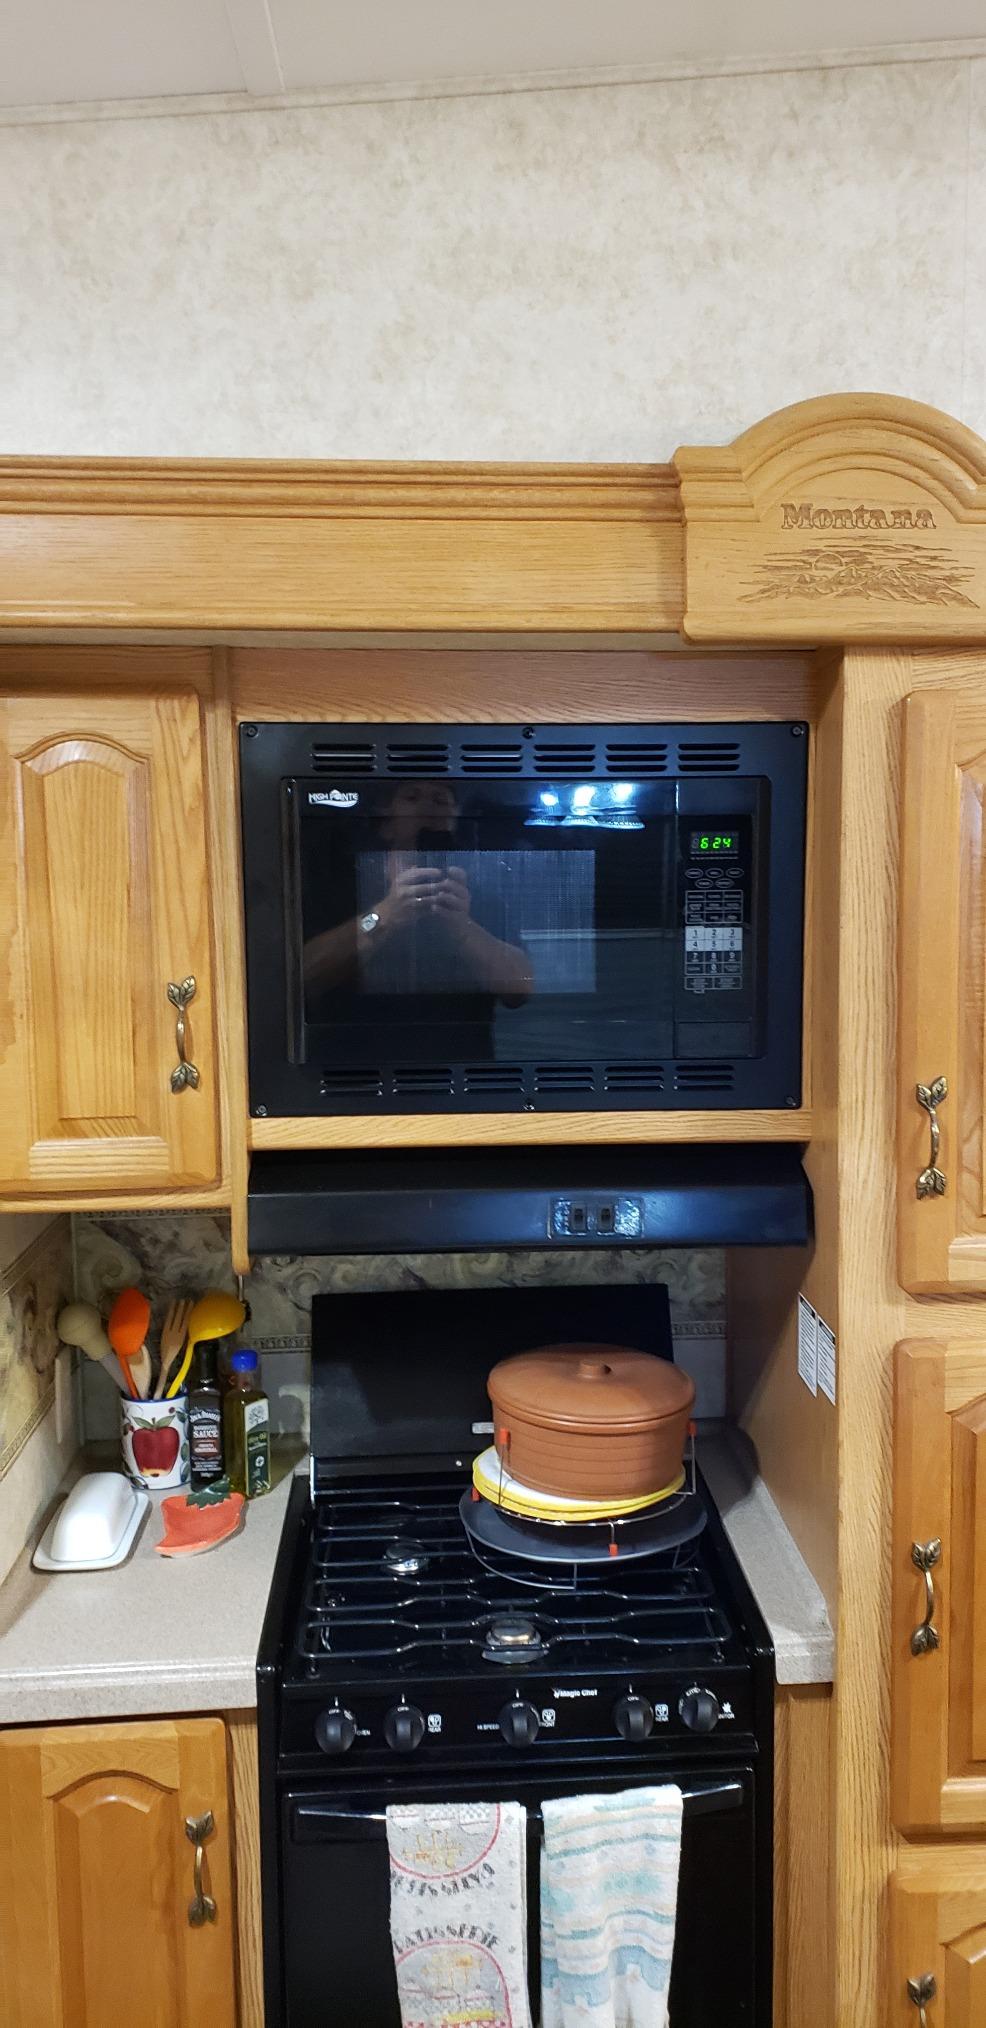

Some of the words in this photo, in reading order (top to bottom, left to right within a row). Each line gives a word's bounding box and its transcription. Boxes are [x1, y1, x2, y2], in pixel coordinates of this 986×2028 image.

[781, 502, 937, 530] Montana
[193, 1430, 218, 1439] SAUCE
[560, 1689, 581, 1698] Magic
[581, 1689, 598, 1697] Chef
